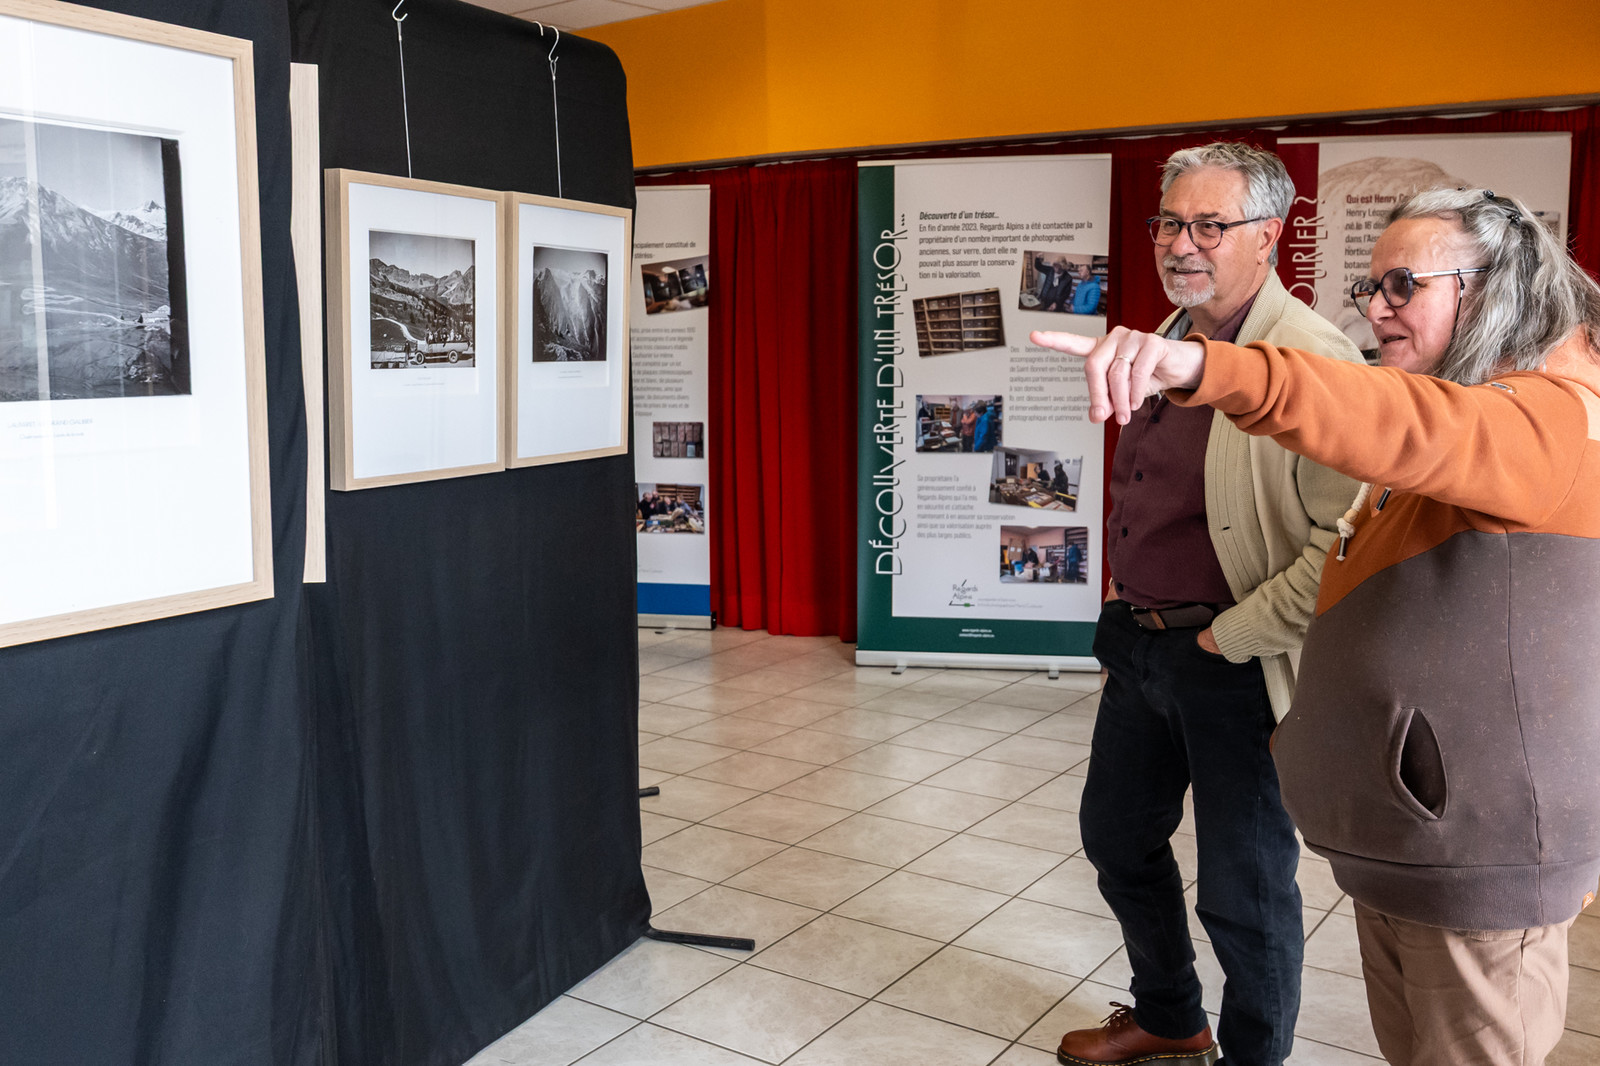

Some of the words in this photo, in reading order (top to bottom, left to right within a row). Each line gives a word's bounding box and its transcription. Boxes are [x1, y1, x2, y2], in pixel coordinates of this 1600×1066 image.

[1346, 195, 1359, 204] Qui
[1360, 195, 1372, 204] est
[1375, 194, 1396, 204] Henry
[920, 211, 957, 220] Découverte
[959, 211, 973, 219] d'un
[1346, 209, 1366, 217] Henry
[980, 223, 1004, 232] Regards
[919, 236, 953, 245] propriétaire
[1031, 234, 1074, 243] photographies
[1345, 235, 1362, 243] dans
[1288, 216, 1328, 311] OURIER
[873, 329, 905, 388] D'UN
[868, 398, 908, 576] DÉCOUVERTE
[952, 584, 978, 594] Regards
